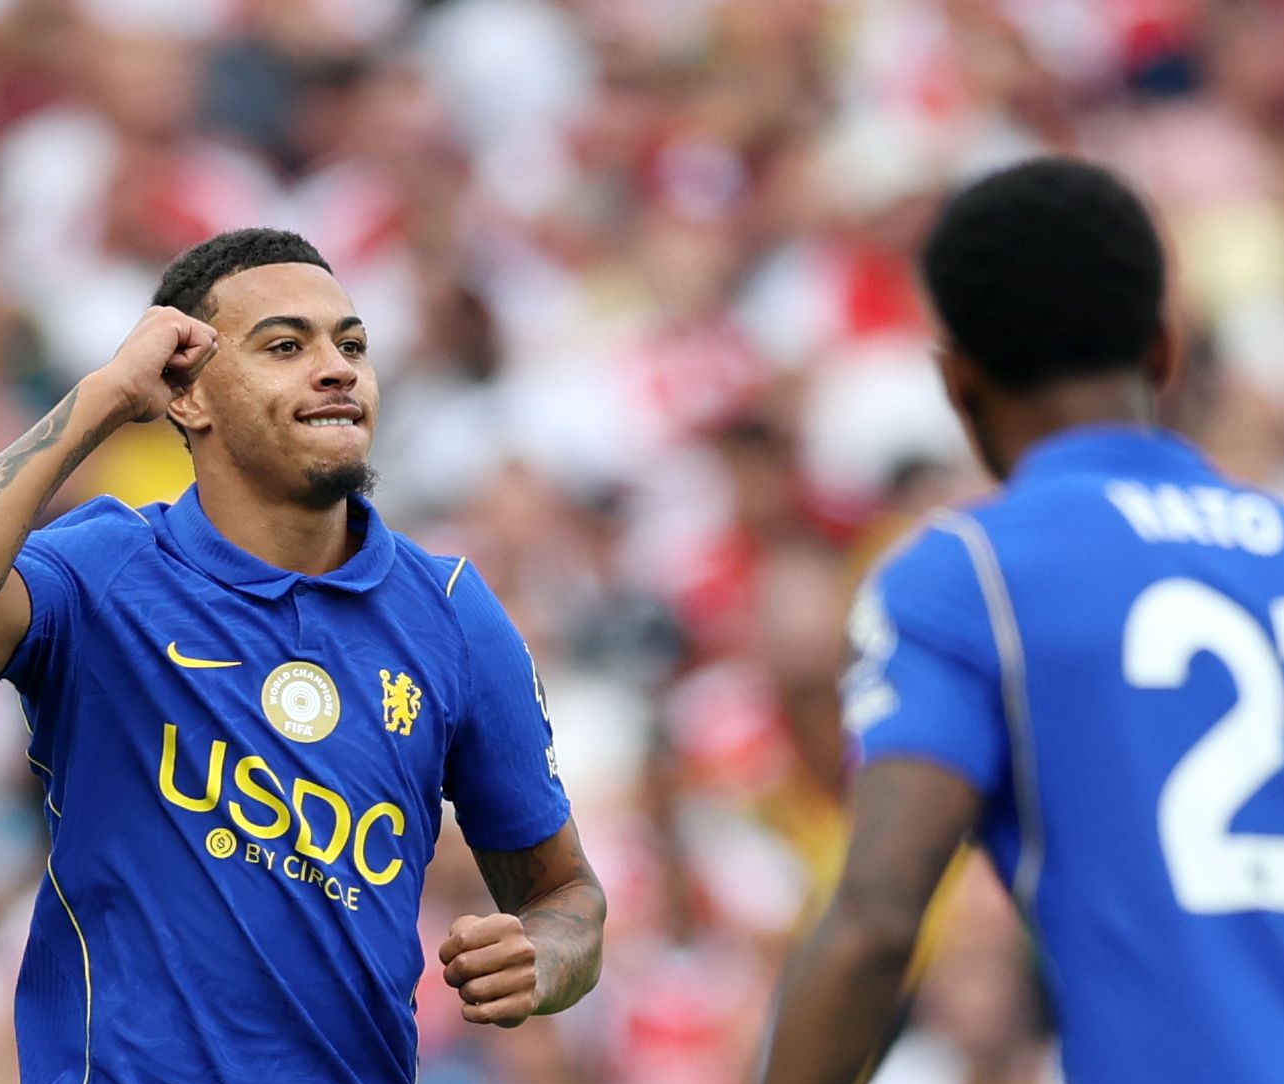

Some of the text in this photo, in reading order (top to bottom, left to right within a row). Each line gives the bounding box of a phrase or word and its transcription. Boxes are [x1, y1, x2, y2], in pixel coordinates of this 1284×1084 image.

[269, 668, 333, 717] WORLD CHAMPIONS
[283, 720, 314, 737] FIFA
[158, 723, 405, 885] USDC
[245, 843, 361, 911] BY CIRCLE
